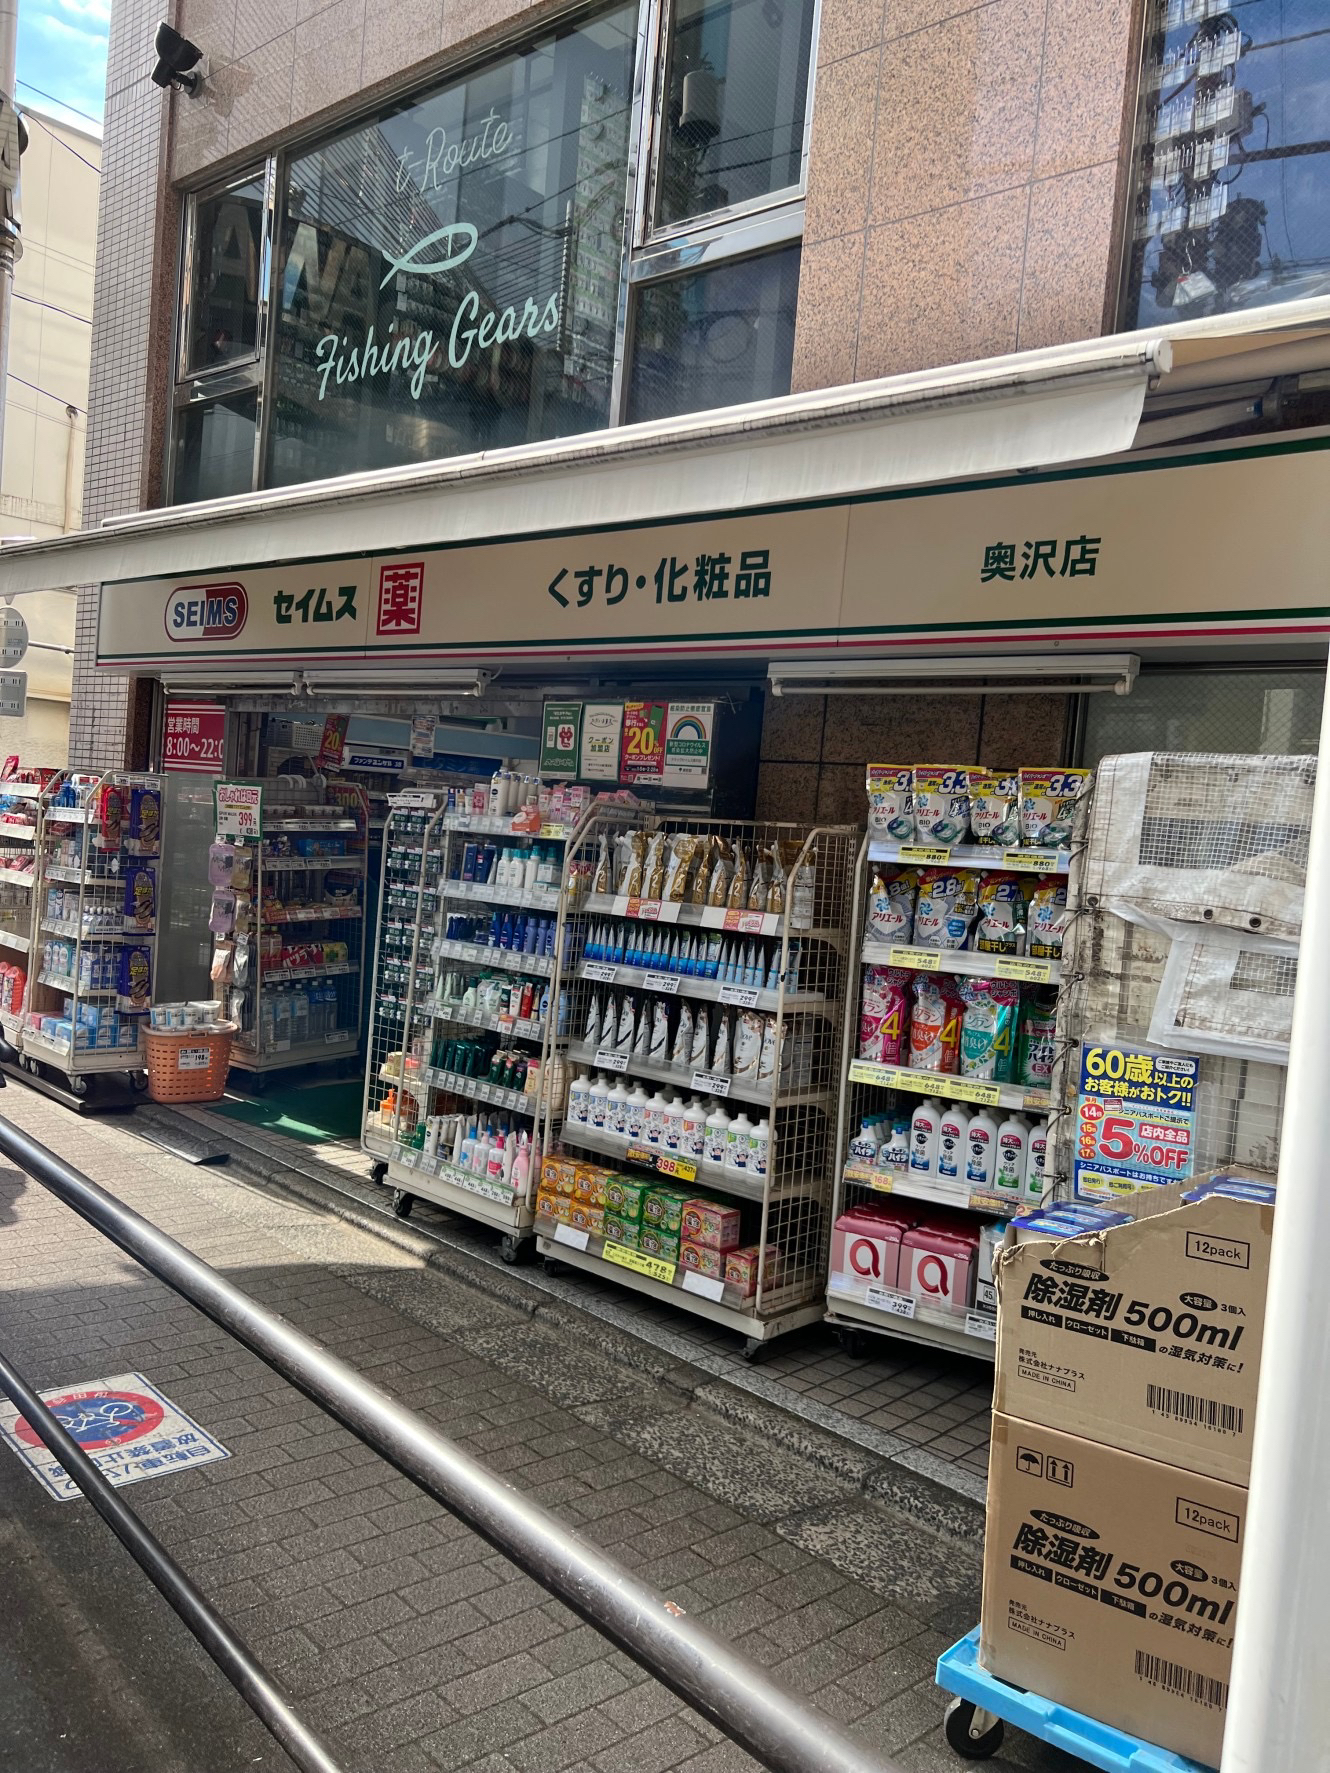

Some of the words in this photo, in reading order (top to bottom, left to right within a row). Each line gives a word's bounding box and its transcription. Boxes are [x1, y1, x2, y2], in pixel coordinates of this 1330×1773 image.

[316, 324, 440, 400] Fishing
[449, 291, 560, 369] Gears
[980, 535, 1102, 583] 奥沢店
[547, 549, 772, 608] くすり・化粧品
[274, 586, 358, 624] セイムス
[381, 570, 418, 628] 薬
[173, 597, 239, 629] SEIMS
[167, 716, 200, 735] 営業時間
[325, 731, 340, 749] 20
[588, 736, 614, 744] クーポン
[627, 727, 655, 755] 20
[239, 811, 252, 826] 399
[871, 912, 903, 923] アリエール
[880, 1011, 900, 1041] 4
[940, 1018, 958, 1048] 4
[993, 1026, 1011, 1057] 4
[1035, 1064, 1049, 1074] EX
[1086, 1048, 1194, 1088] 60歳以上の
[975, 1091, 992, 1099] 648
[1141, 1125, 1188, 1143] 店内全品
[656, 1158, 676, 1172] 398
[874, 1175, 888, 1185] 168
[1194, 1240, 1242, 1260] 12pack
[645, 1261, 667, 1274] 478
[1049, 1260, 1101, 1281] たっぷり吸収
[892, 1301, 908, 1310] 399
[983, 1289, 993, 1300] 45
[1184, 1295, 1214, 1309] 大容量
[1023, 1272, 1123, 1321] 除湿剤
[1123, 1300, 1245, 1351] 500ml
[1221, 1303, 1247, 1316] 3個入
[1028, 1309, 1056, 1324] 押し入れ
[1066, 1319, 1108, 1336] クローゼット
[1159, 1345, 1245, 1374] の湿気対策に!
[1018, 1355, 1085, 1380] 株式会社ナナプラス
[1022, 1369, 1040, 1380] MADE
[1043, 1374, 1051, 1383] IN
[1051, 1376, 1072, 1389] CHINA
[1039, 1512, 1091, 1537] たっぷり吸収
[1184, 1507, 1231, 1534] 12pack
[1012, 1522, 1113, 1581] 除湿剤
[1113, 1561, 1235, 1625] 500ml
[1017, 1559, 1046, 1577] 押し入れ
[1056, 1574, 1098, 1596] クローゼット
[1174, 1562, 1205, 1580] 大容量
[1211, 1574, 1237, 1592] 3個入
[1008, 1607, 1076, 1640] 株式会社ナナプラス
[1012, 1621, 1031, 1634] MADE
[1033, 1628, 1040, 1637] IN
[1041, 1630, 1063, 1647] CHINA
